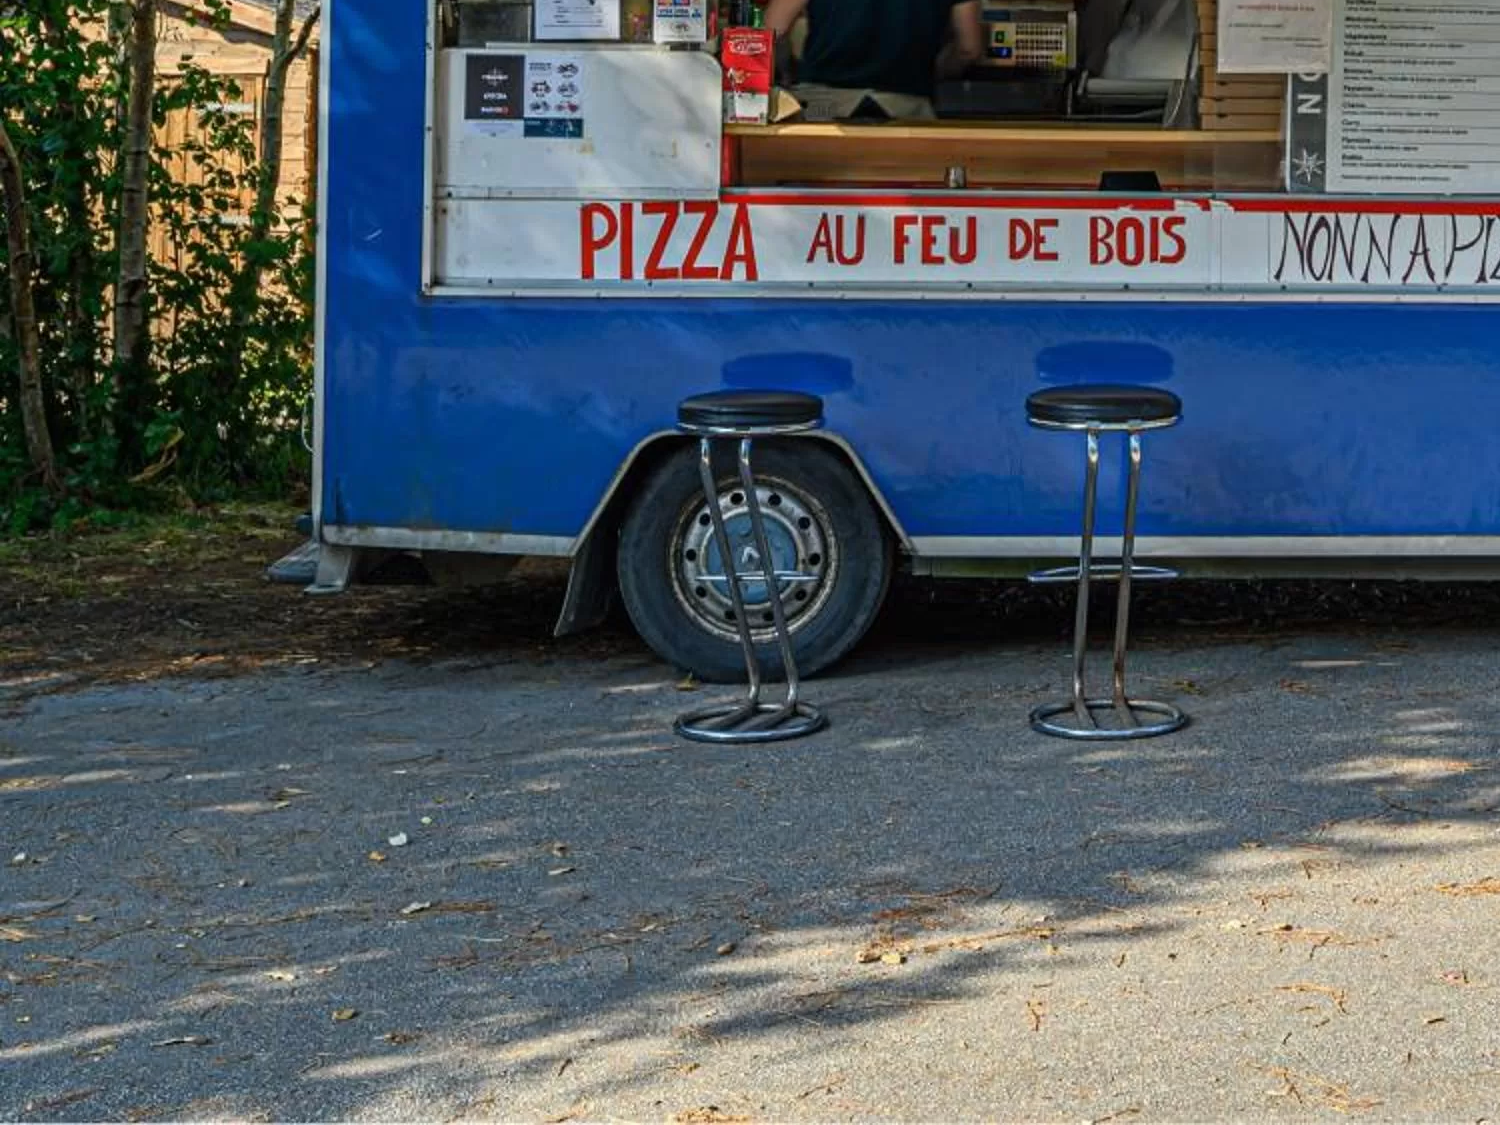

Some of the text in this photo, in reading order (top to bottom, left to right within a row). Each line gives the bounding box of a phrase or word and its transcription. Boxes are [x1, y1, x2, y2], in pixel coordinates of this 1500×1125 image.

[579, 202, 1188, 280] PIZZA AU FEU DE BOIS
